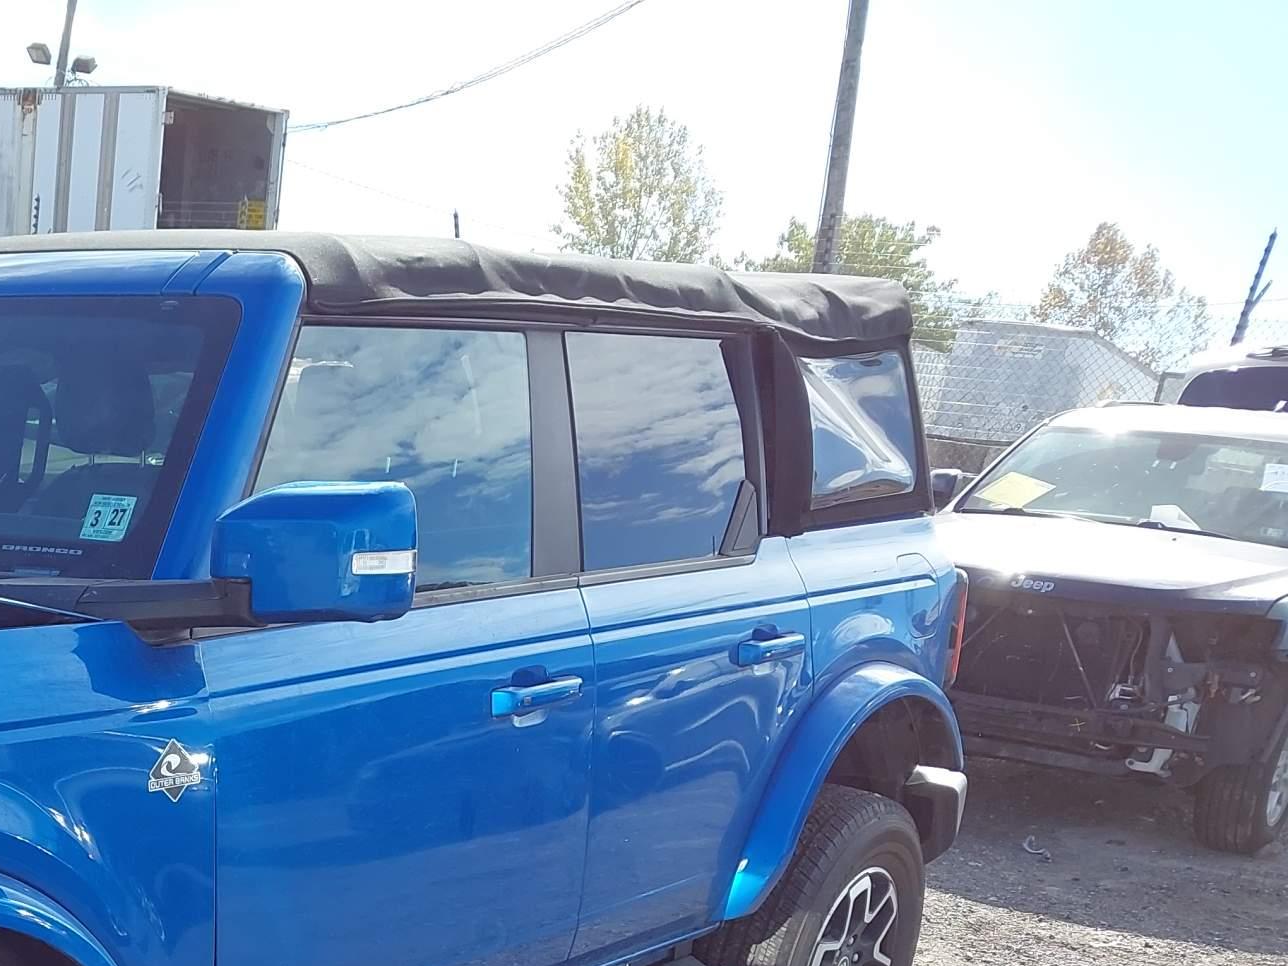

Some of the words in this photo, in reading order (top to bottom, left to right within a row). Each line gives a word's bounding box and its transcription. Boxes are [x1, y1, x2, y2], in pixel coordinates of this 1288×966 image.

[90, 510, 102, 527] 3
[108, 508, 127, 526] 27
[1, 544, 83, 555] BRONCO
[1010, 574, 1055, 593] Jeep
[150, 778, 174, 789] OUTER
[175, 774, 199, 785] BANKS
